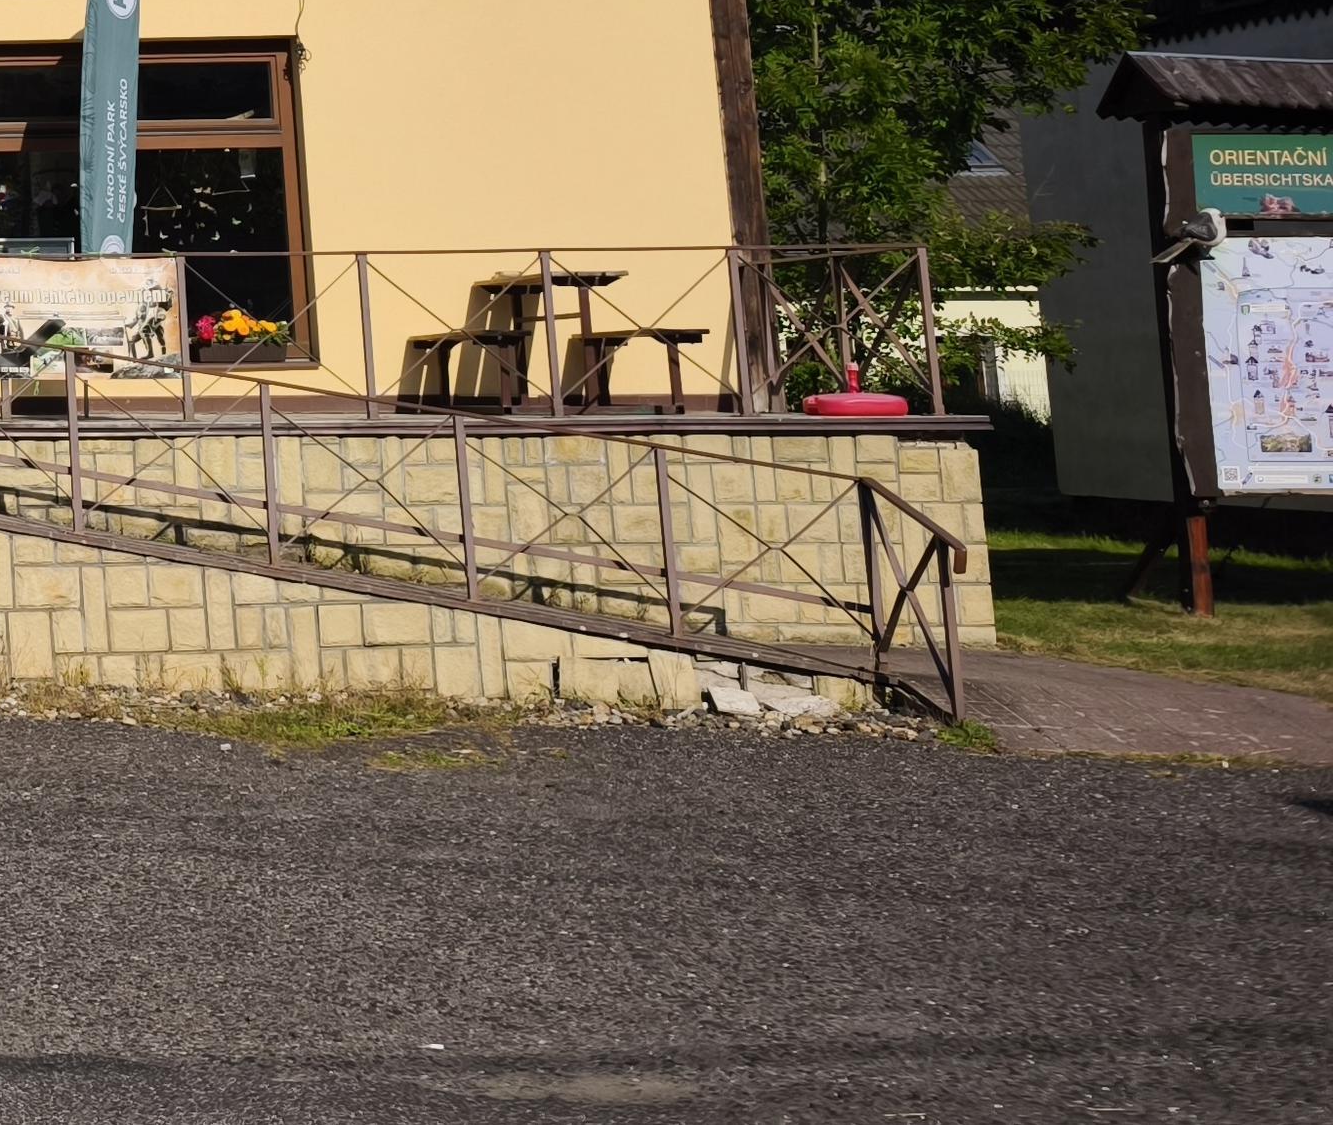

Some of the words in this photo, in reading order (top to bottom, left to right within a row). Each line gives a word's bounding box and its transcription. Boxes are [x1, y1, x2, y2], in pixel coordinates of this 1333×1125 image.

[106, 100, 116, 143] PARK
[117, 78, 129, 172] ŠVÝCARSKO
[1209, 146, 1328, 166] ORIENTAČNÍ
[105, 144, 115, 220] NÁRODNÍ
[117, 174, 127, 223] ČESKÉ
